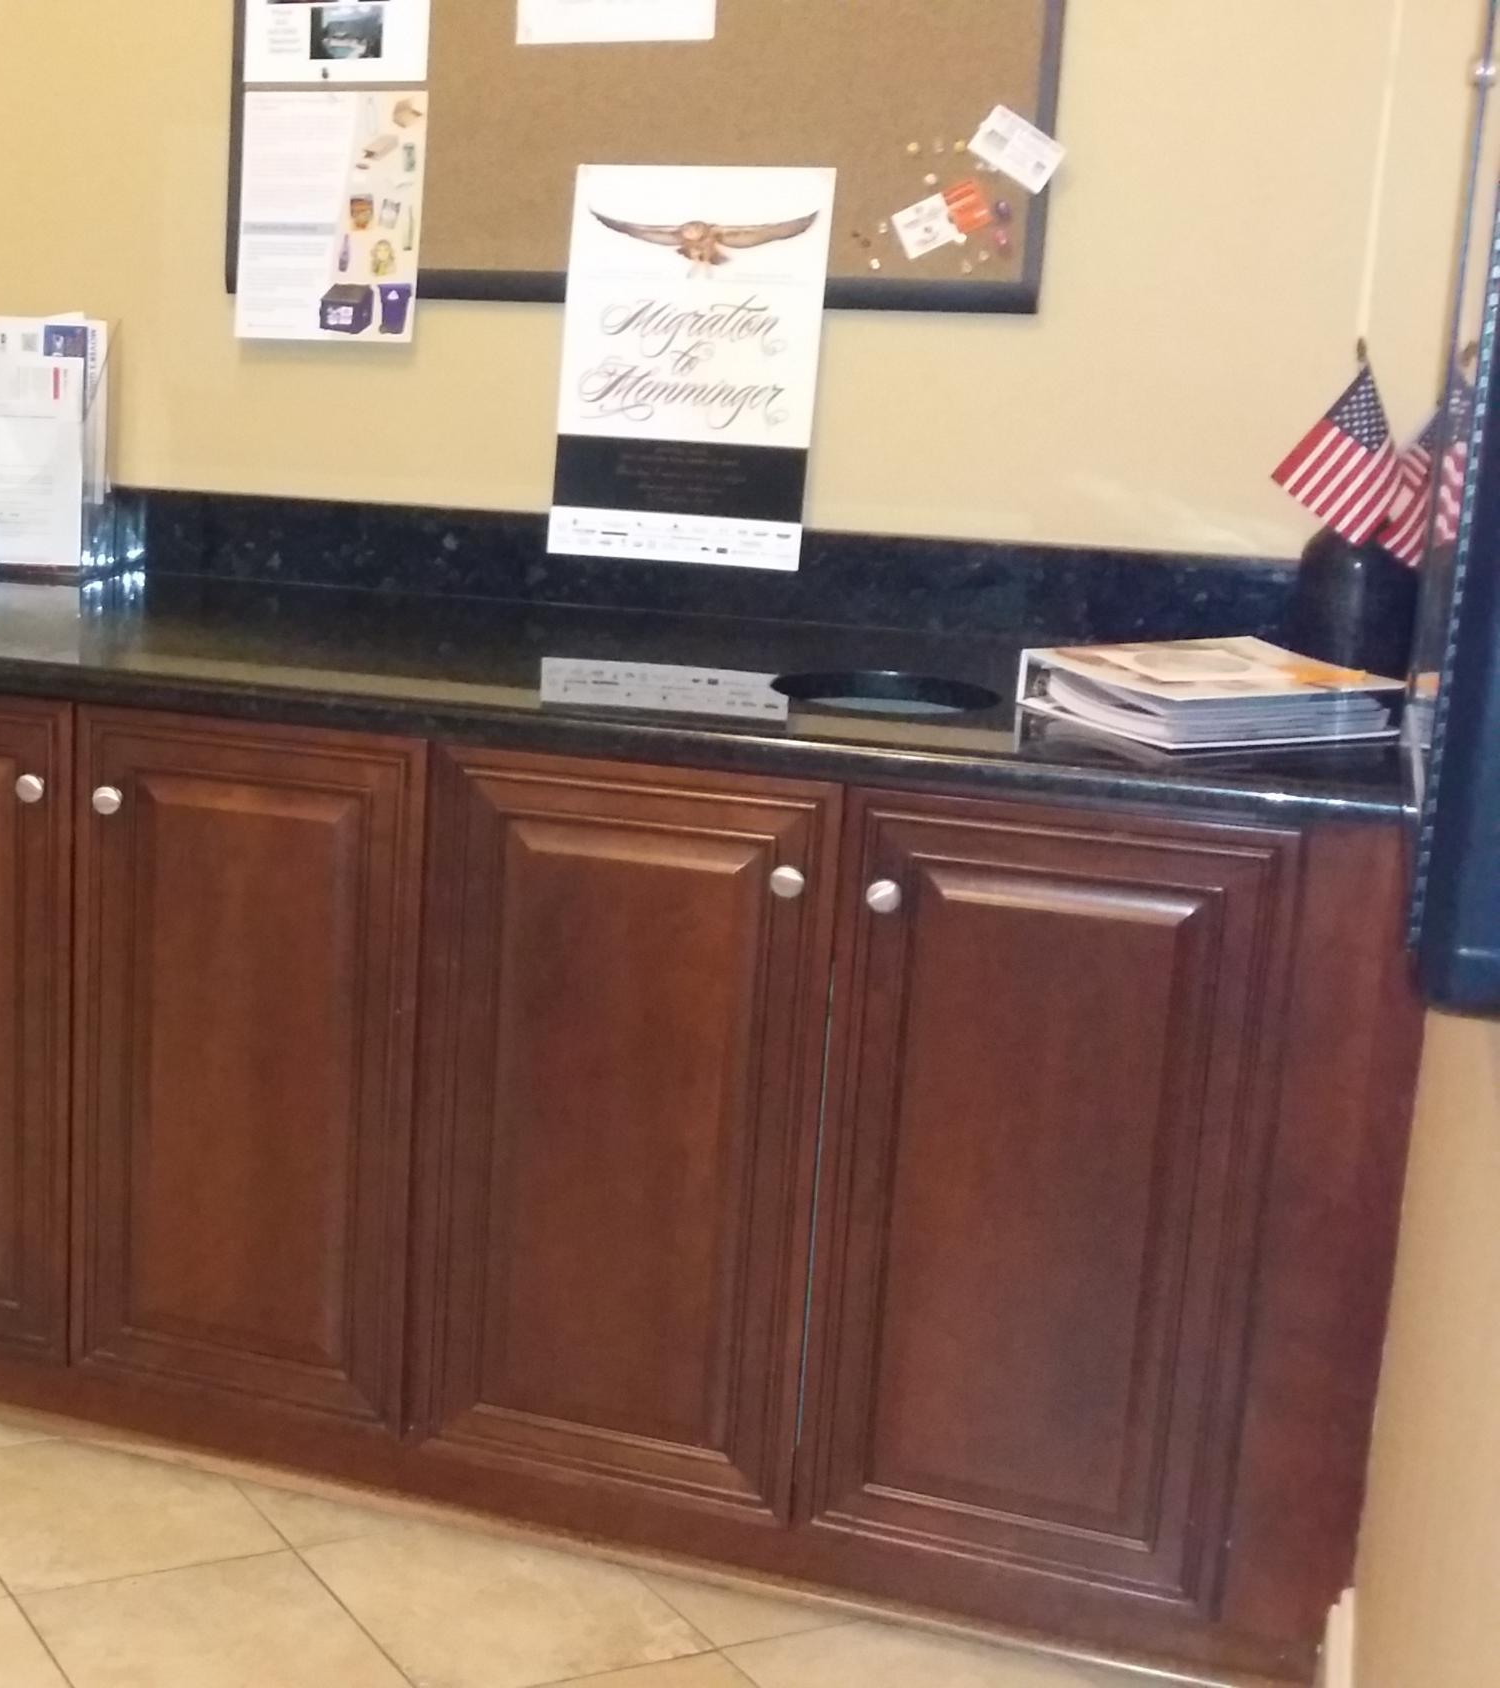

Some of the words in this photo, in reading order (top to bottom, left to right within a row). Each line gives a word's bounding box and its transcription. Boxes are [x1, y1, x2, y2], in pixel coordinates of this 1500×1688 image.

[601, 295, 788, 358] Migration
[670, 339, 716, 376] to
[579, 356, 789, 430] Memminger
